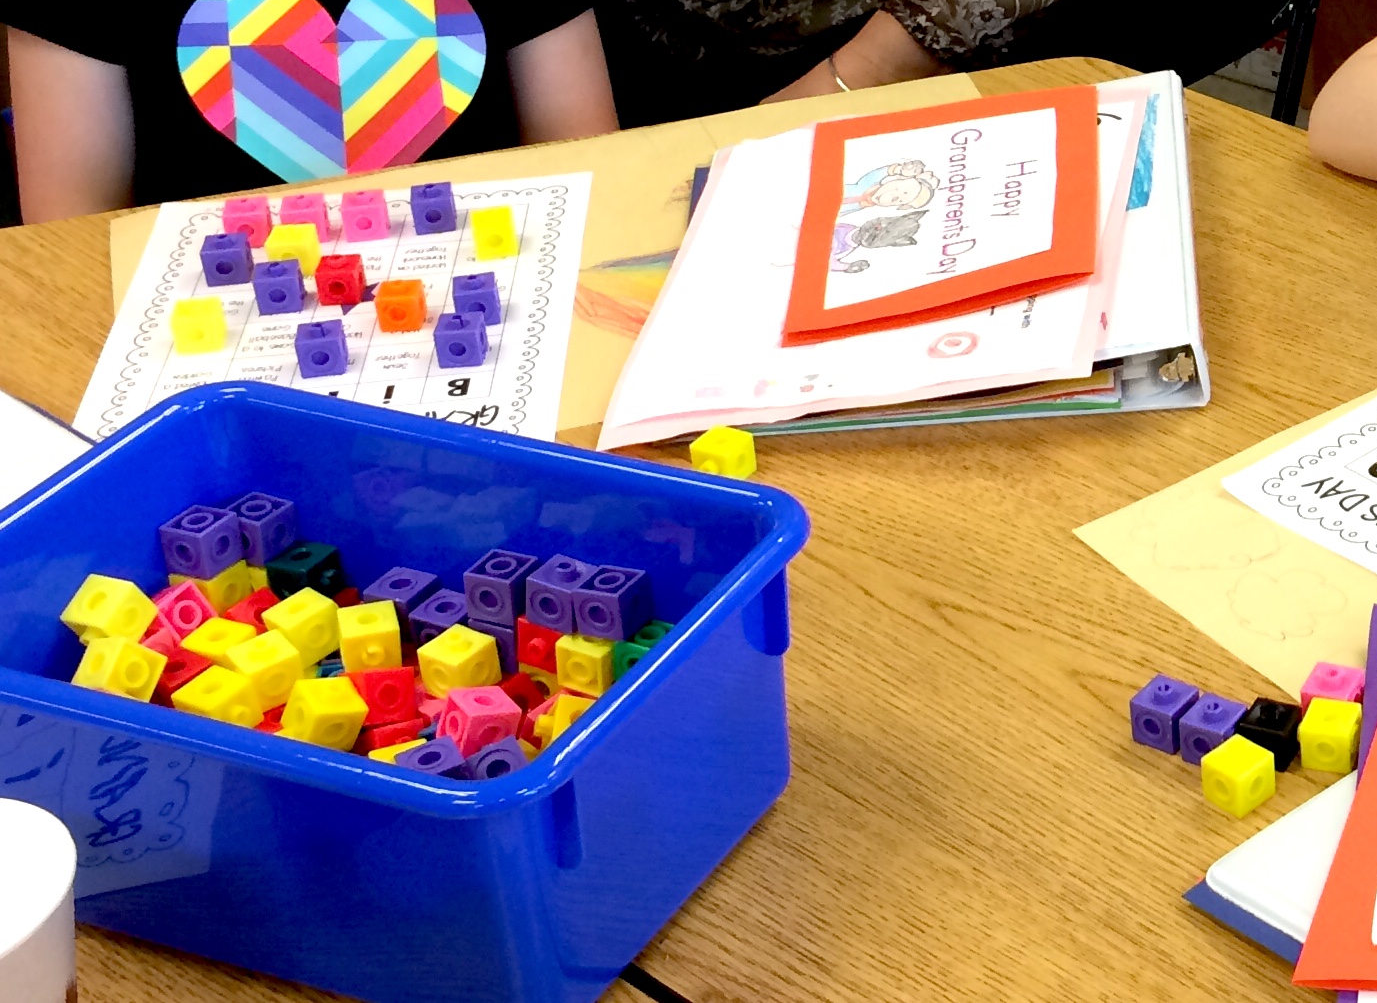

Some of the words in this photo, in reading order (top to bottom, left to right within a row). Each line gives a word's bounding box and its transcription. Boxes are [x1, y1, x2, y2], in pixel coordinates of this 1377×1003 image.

[938, 128, 982, 240] Grandparents
[990, 160, 1038, 216] Happy
[926, 238, 976, 275] Day
[448, 378, 471, 396] B
[1301, 477, 1370, 511] DAY
